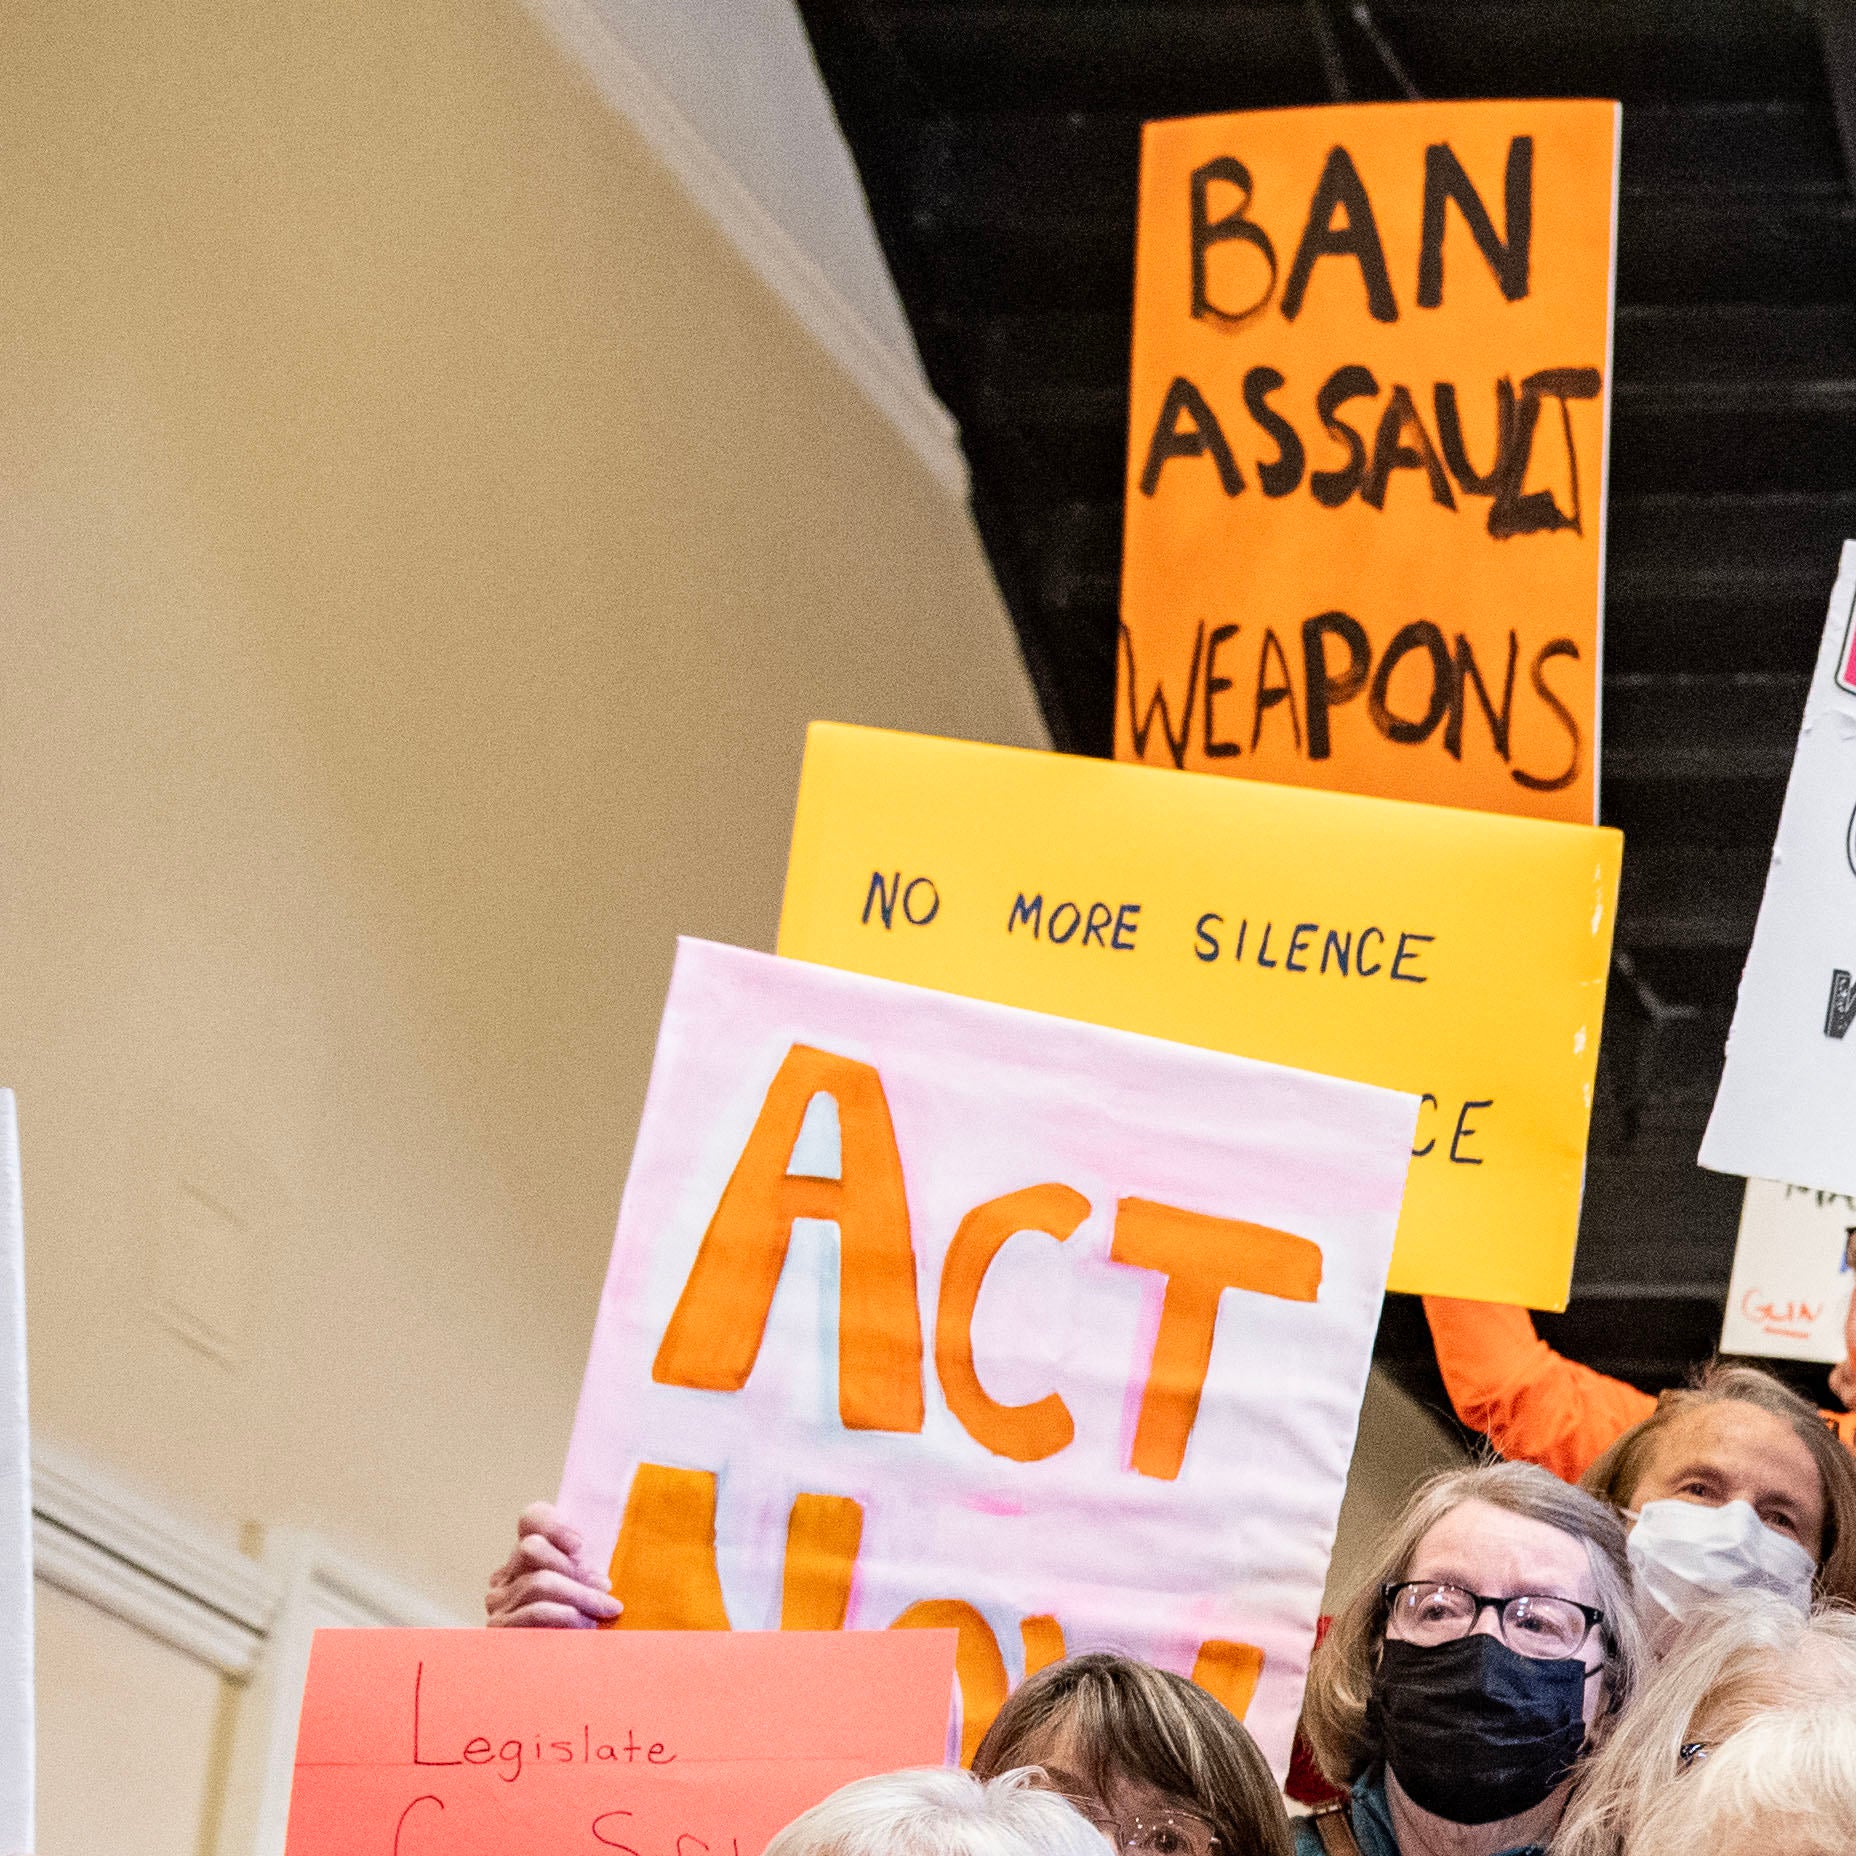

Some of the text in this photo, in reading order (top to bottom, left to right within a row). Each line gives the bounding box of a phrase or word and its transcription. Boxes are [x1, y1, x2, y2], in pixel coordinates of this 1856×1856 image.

[1190, 135, 1533, 326] BAN
[1139, 365, 1602, 540] ASSAULT
[1120, 612, 1582, 790] WEAPONS
[863, 872, 1436, 983] NO MORE SILENCE
[652, 1043, 1323, 1481] ACT
[413, 1661, 678, 1783] Legislate
